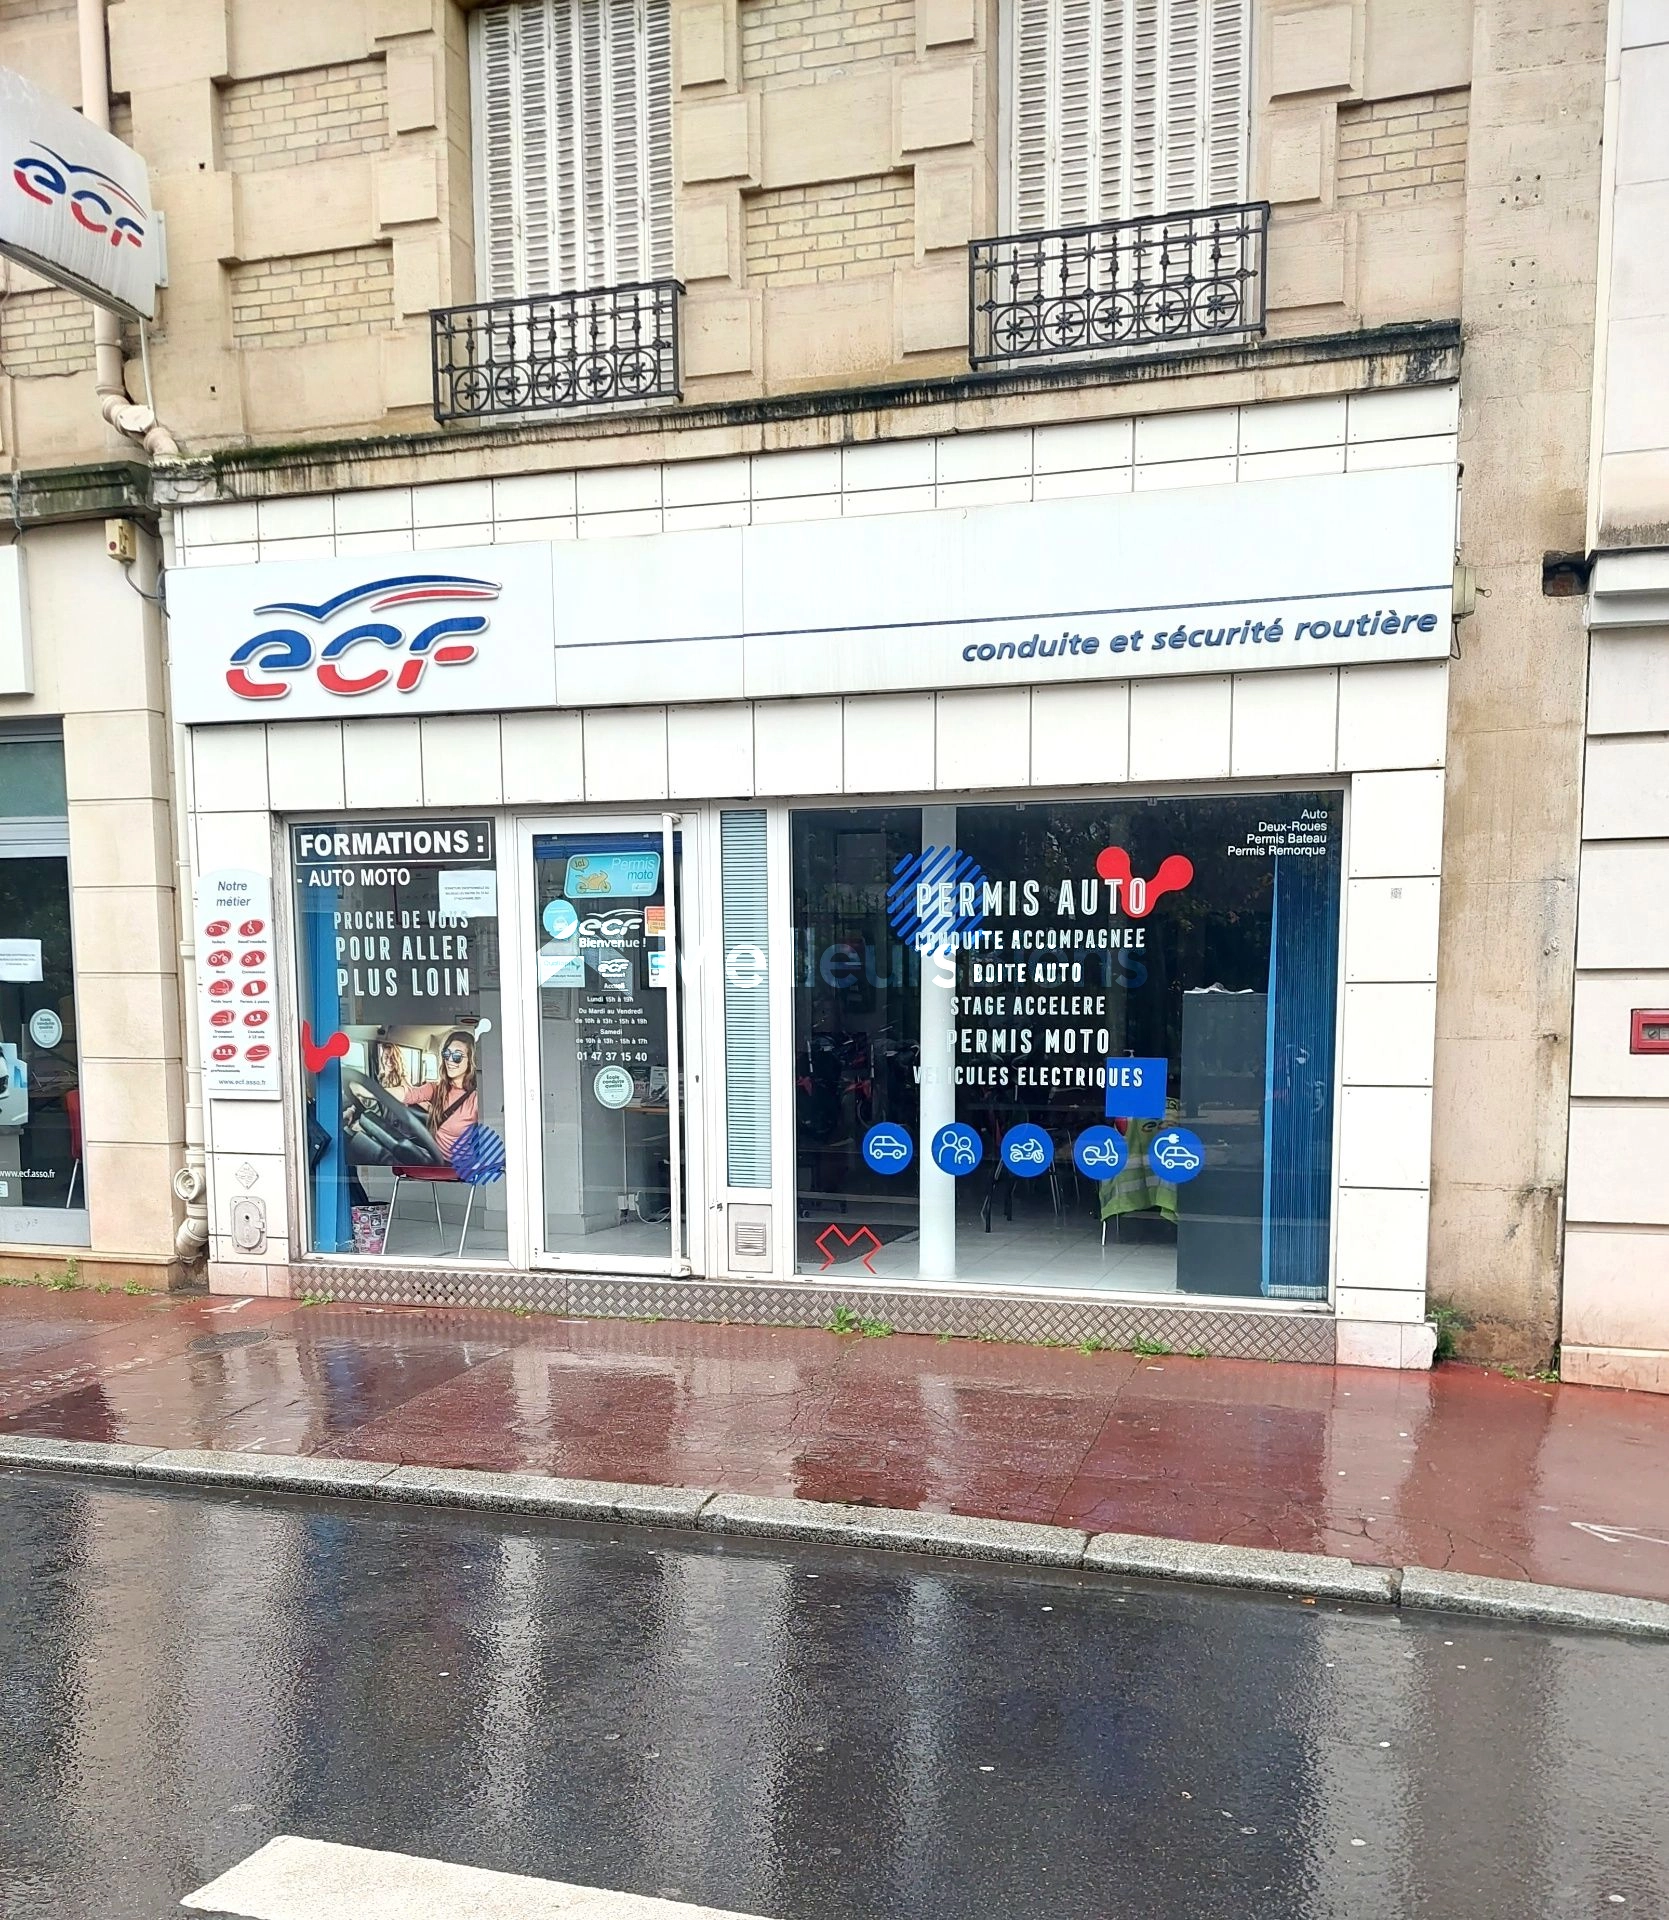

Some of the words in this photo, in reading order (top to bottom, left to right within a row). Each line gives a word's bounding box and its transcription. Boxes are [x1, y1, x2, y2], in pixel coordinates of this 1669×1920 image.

[962, 632, 1099, 662] conduite
[1109, 629, 1142, 654] et
[1151, 617, 1283, 650] sécurité
[1294, 609, 1438, 641] routière
[1300, 808, 1328, 820] Auto
[1258, 821, 1328, 832] Deux-Roues
[300, 829, 469, 857] FORMATIONS
[1246, 833, 1285, 845] Permis
[1287, 832, 1327, 844] Bateau
[1227, 845, 1266, 857] Permis
[1268, 844, 1326, 858] Remorque
[611, 857, 655, 870] Permis
[308, 868, 355, 887] AUTO
[360, 867, 411, 886] MOTO
[627, 870, 654, 880] moto
[217, 881, 248, 891] Notre
[216, 896, 251, 907] métier
[915, 878, 1040, 918] PERMIS
[1057, 878, 1147, 916] AUTO
[333, 910, 395, 930] PROCHE
[401, 910, 420, 929] DE
[427, 909, 469, 929] VOUS
[335, 936, 391, 961] POUR
[401, 935, 469, 961] ALLER
[578, 937, 640, 948] Bienvenue
[914, 929, 1004, 951] CONDUITE
[1011, 927, 1146, 950] ACCOMPAGNEE
[336, 967, 398, 997] PLUS
[411, 967, 470, 997] LOIN
[973, 962, 1026, 984] BOITE
[1034, 962, 1082, 984] AUTO
[949, 996, 1006, 1017] STAGE
[1012, 996, 1106, 1016] ACCELERE
[946, 1028, 1033, 1054] PERMIS
[1044, 1028, 1110, 1054] MOTO
[576, 1051, 588, 1061] 01
[590, 1051, 602, 1061] 47
[605, 1051, 617, 1061] 37
[620, 1052, 631, 1062] 15
[634, 1052, 648, 1062] 40
[912, 1066, 1009, 1085] VEICULES
[1017, 1066, 1143, 1088] ELECTRIQUES
